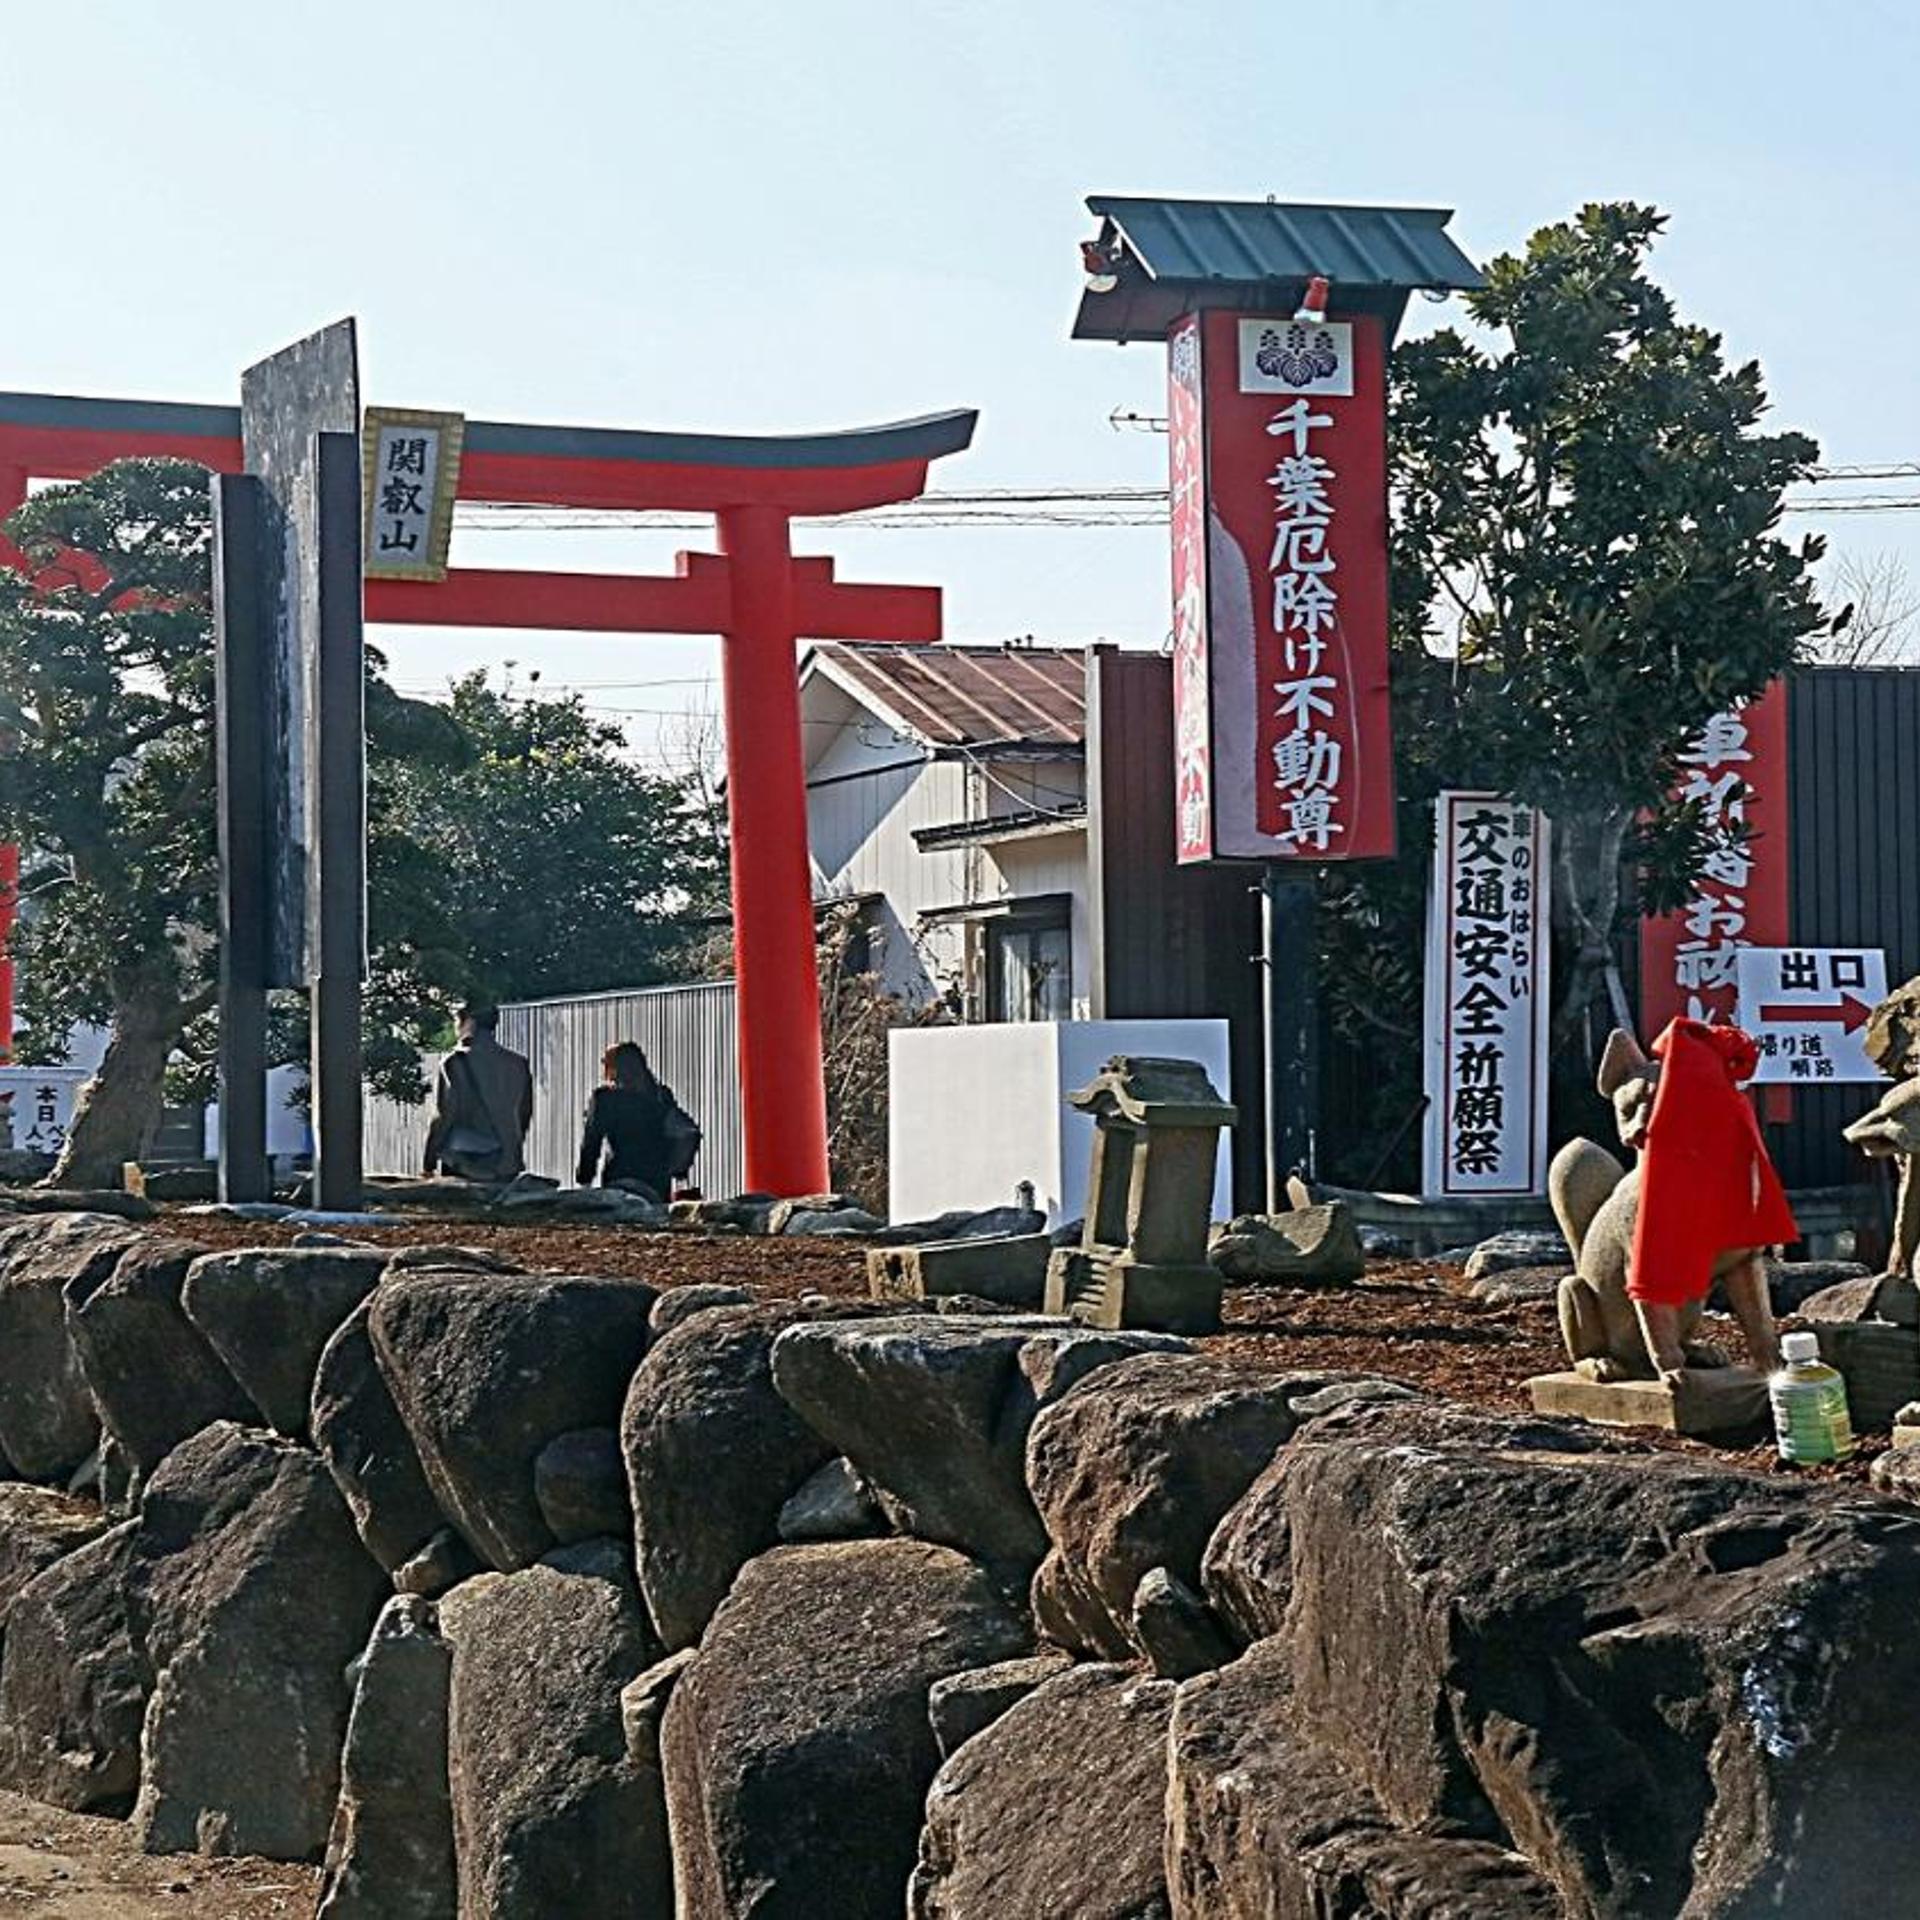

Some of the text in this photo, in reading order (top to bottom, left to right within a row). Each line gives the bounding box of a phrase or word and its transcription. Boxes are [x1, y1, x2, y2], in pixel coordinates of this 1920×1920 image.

[1266, 398, 1343, 850] 千葉厄除け不動尊
[1452, 809, 1509, 1175] 交通安全祈願祭
[1510, 812, 1532, 998] 車のおはらい
[1781, 951, 1866, 991] 出口
[36, 1086, 57, 1121] 本日
